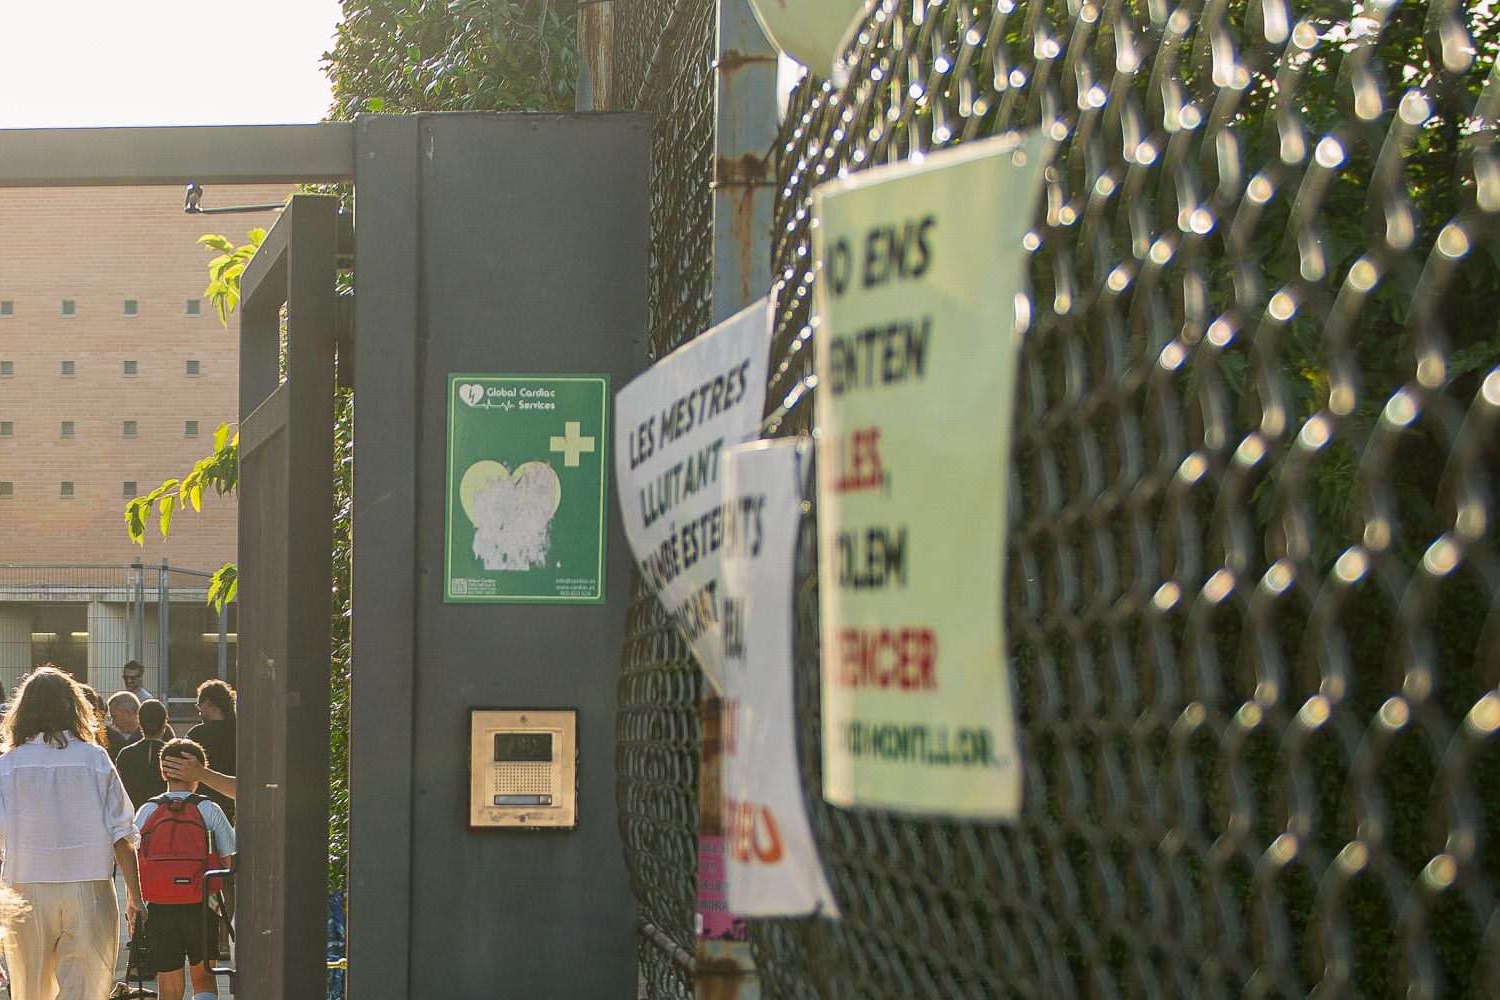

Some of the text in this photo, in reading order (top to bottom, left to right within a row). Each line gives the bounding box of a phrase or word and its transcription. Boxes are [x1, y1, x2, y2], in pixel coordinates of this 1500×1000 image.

[862, 211, 939, 290] ENS
[486, 387, 556, 398] Global Cardiac
[829, 314, 932, 396] ENTEN
[518, 400, 556, 410] Services
[629, 357, 751, 471] LES MESTRES
[639, 437, 726, 528] LLUITANT
